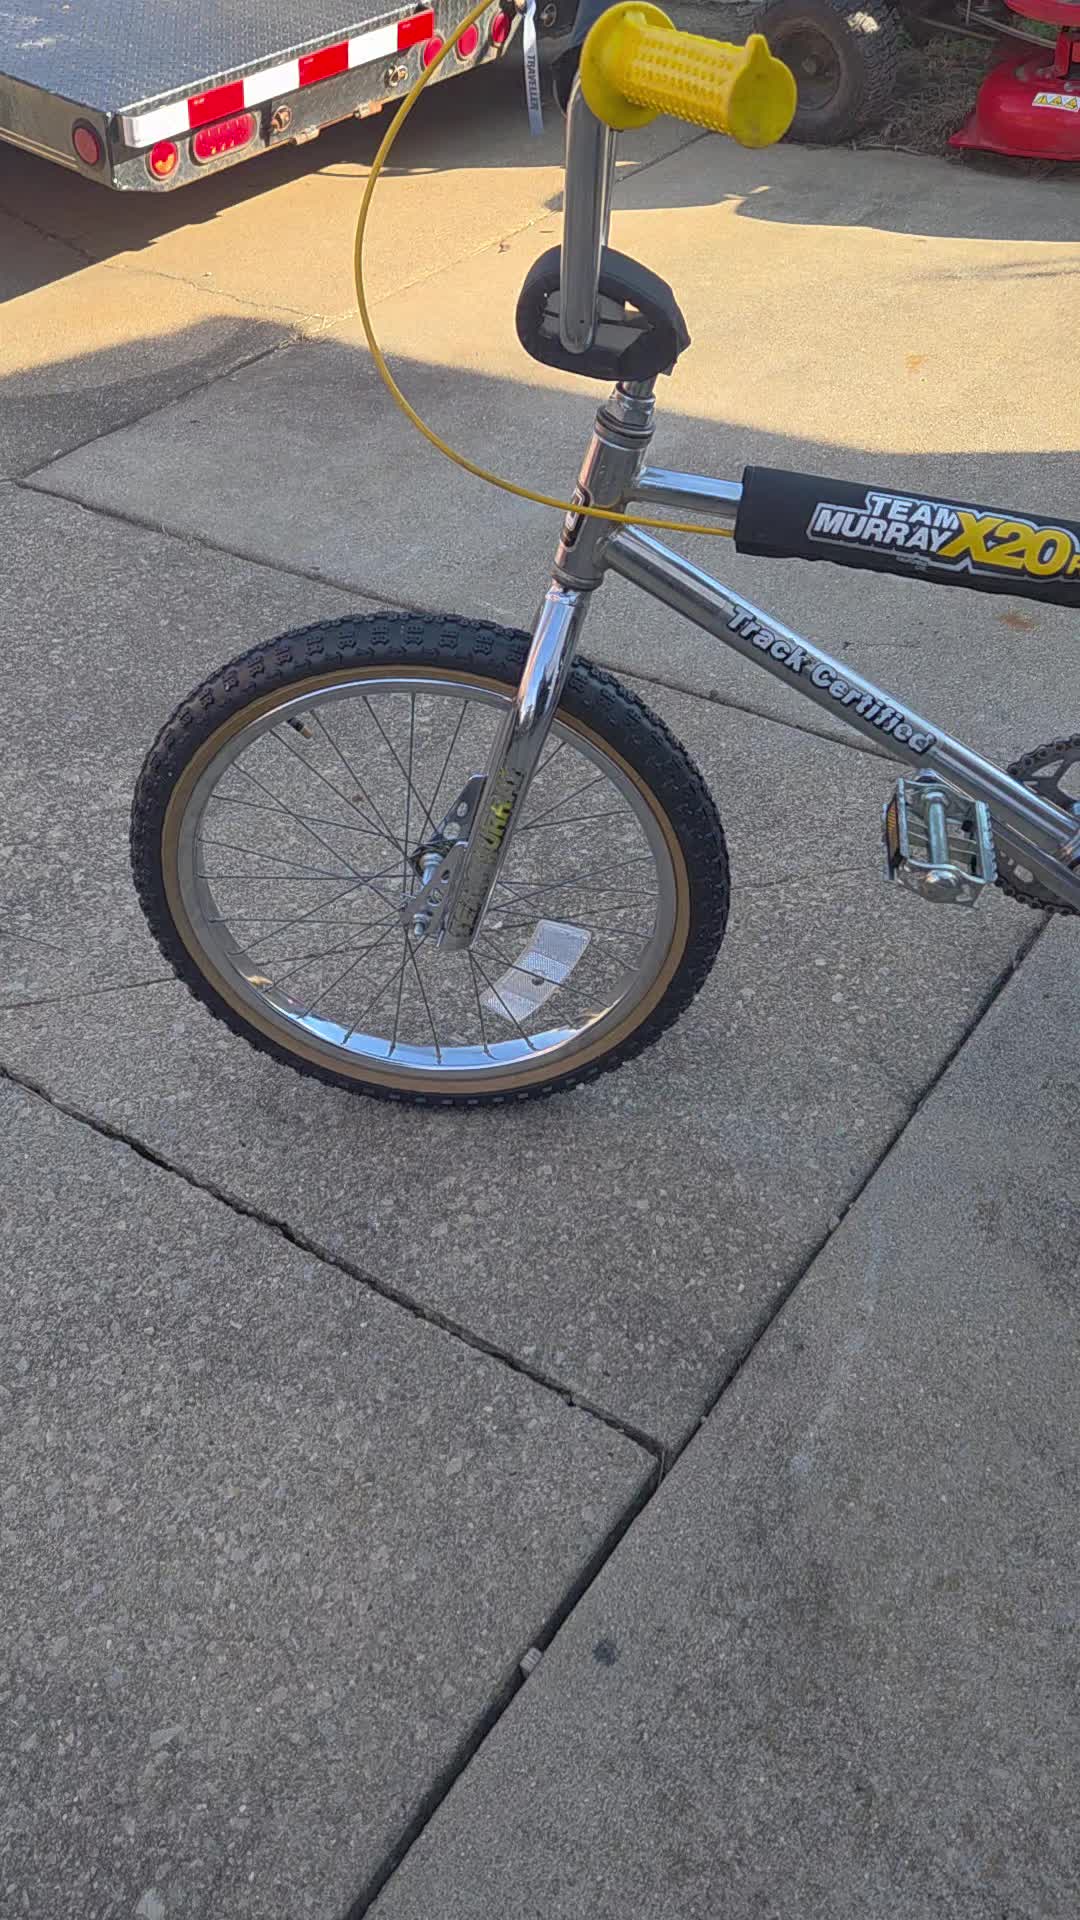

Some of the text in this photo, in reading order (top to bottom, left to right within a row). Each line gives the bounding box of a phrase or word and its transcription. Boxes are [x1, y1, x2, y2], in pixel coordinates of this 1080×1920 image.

[527, 55, 539, 111] TRAVELLER
[813, 509, 954, 553] MURRAY
[870, 496, 960, 530] TEAM
[726, 604, 937, 756] Track Certified
